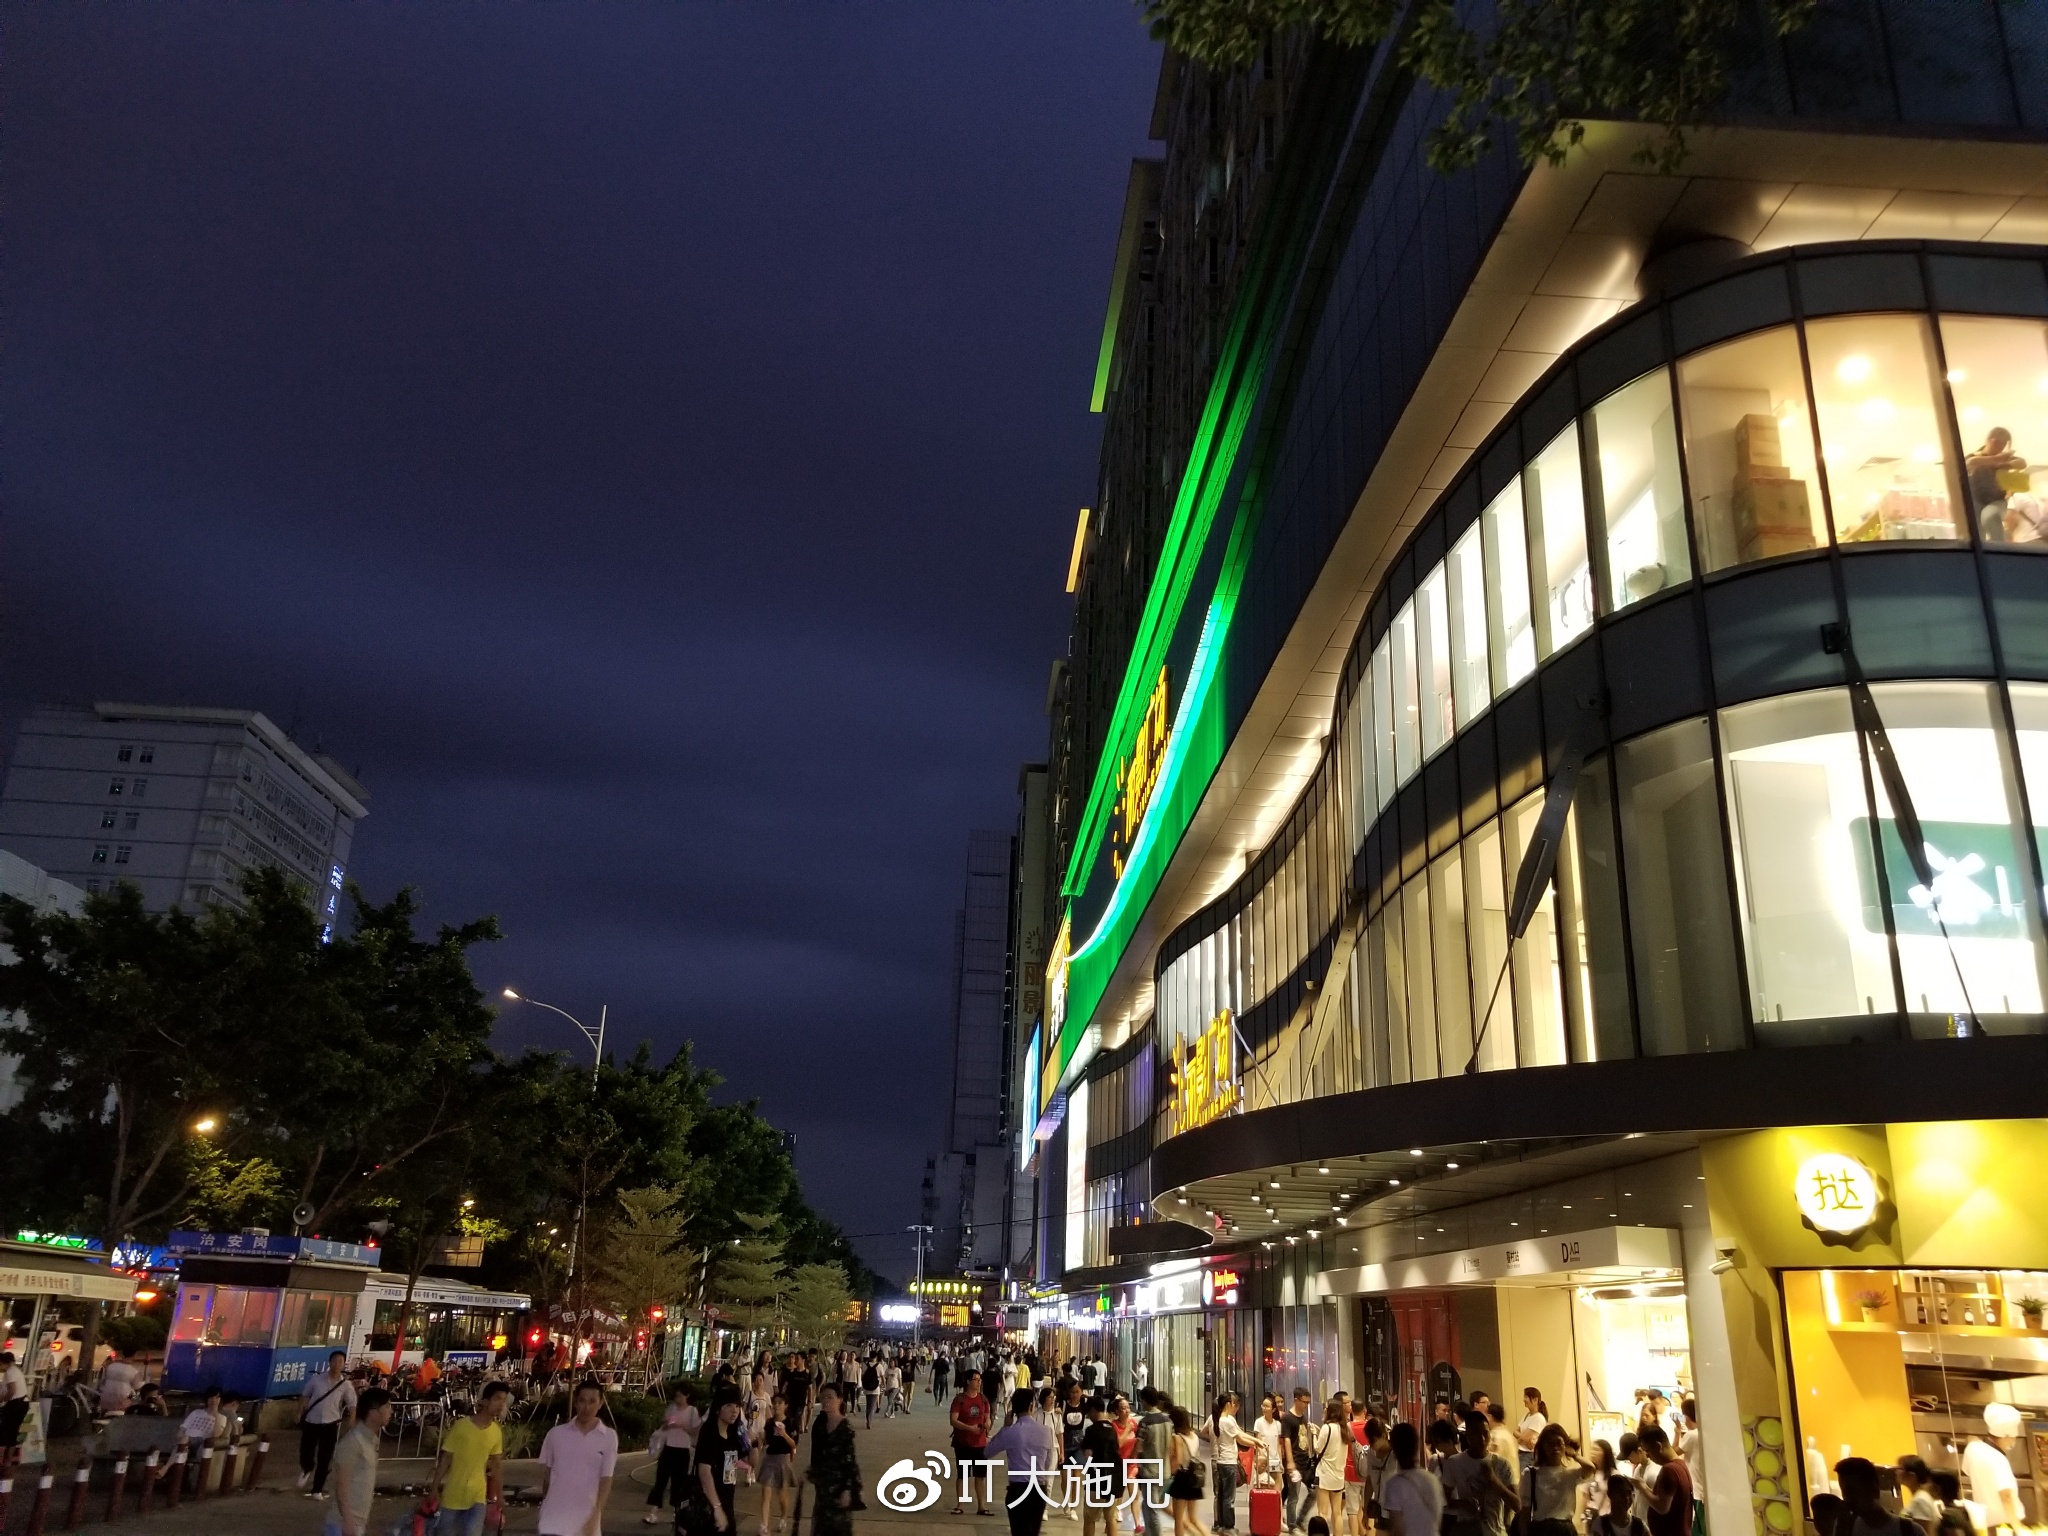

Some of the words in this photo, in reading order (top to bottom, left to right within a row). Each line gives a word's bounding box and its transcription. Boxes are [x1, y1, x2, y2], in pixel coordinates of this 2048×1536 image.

[1811, 1168, 1864, 1211] 挞
[200, 1233, 269, 1249] 治安岗
[1569, 1241, 1580, 1255] 入口
[1561, 1242, 1569, 1263] D
[273, 1361, 307, 1382] 治安防范
